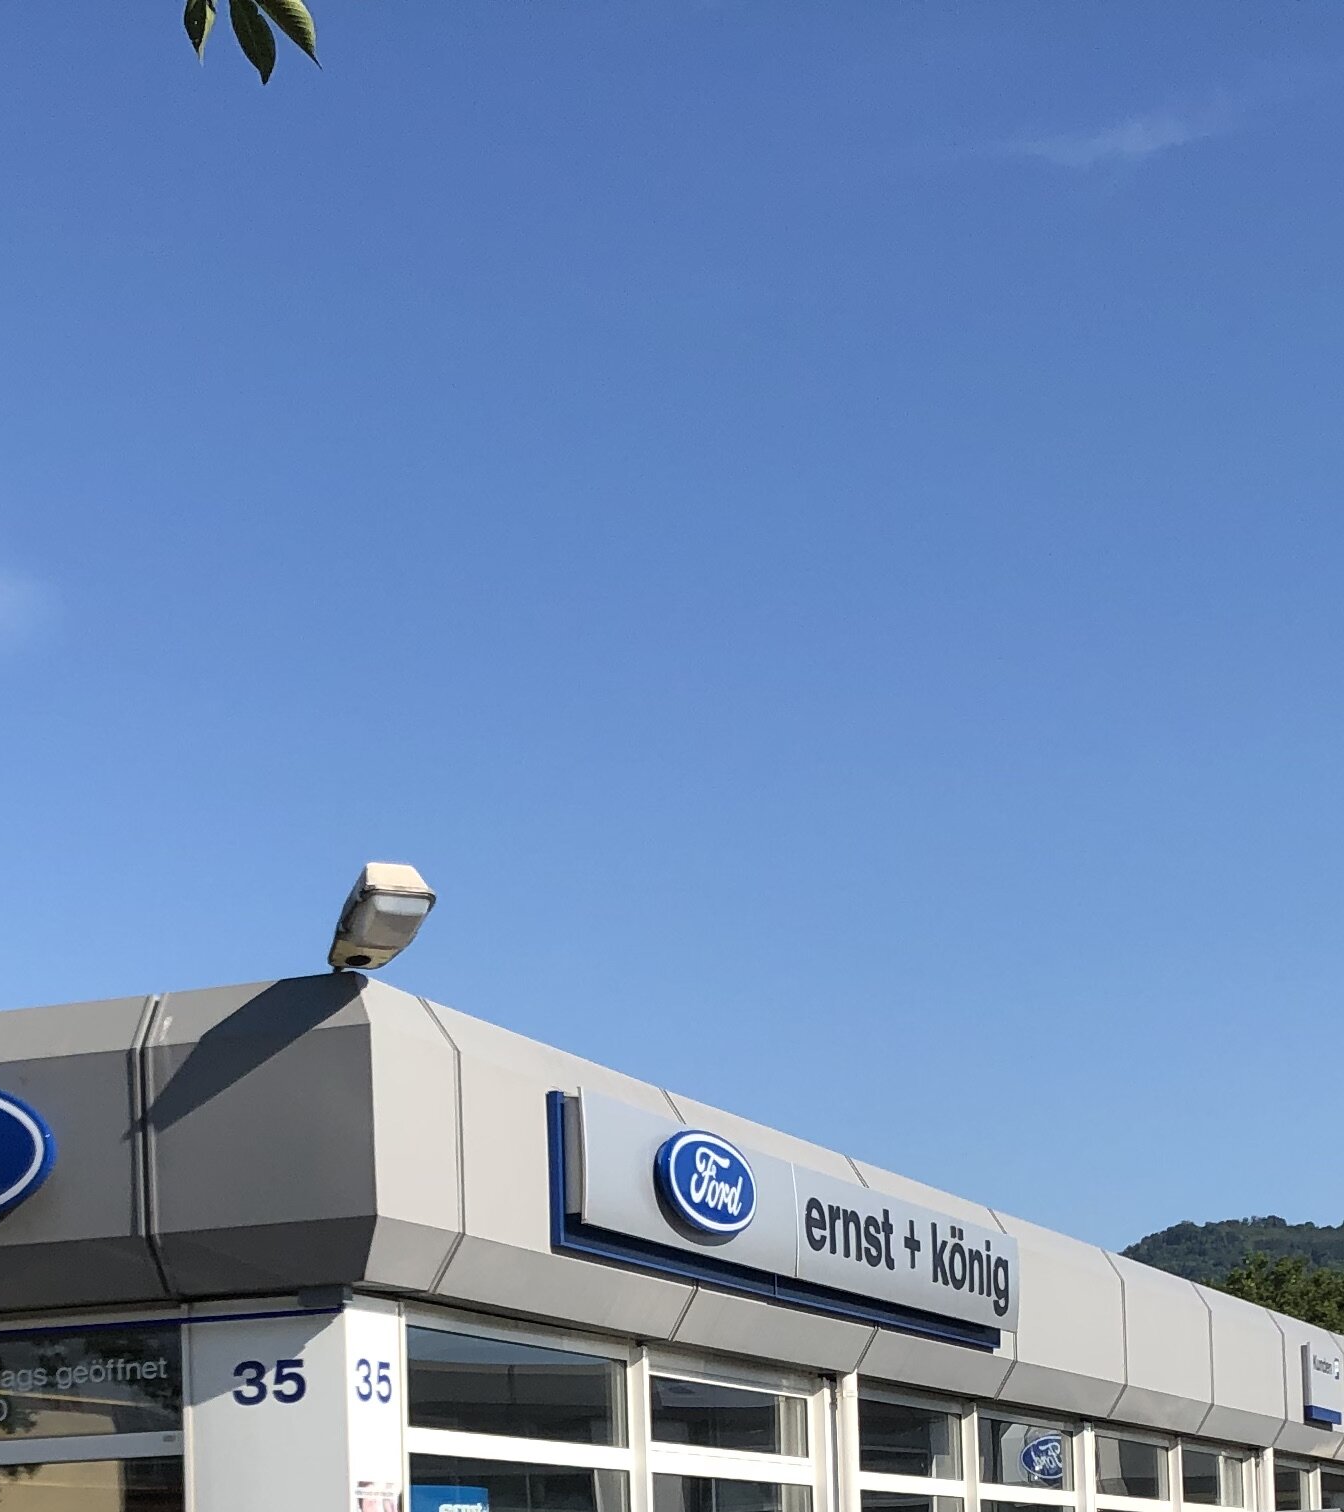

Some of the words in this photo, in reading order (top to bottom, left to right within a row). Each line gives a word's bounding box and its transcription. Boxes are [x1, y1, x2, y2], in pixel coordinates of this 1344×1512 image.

[690, 1146, 743, 1217] Ford
[805, 1197, 895, 1271] ernst
[931, 1222, 1010, 1317] könig
[56, 1356, 168, 1390] geöffnet
[232, 1358, 307, 1407] 35
[355, 1358, 393, 1404] 35
